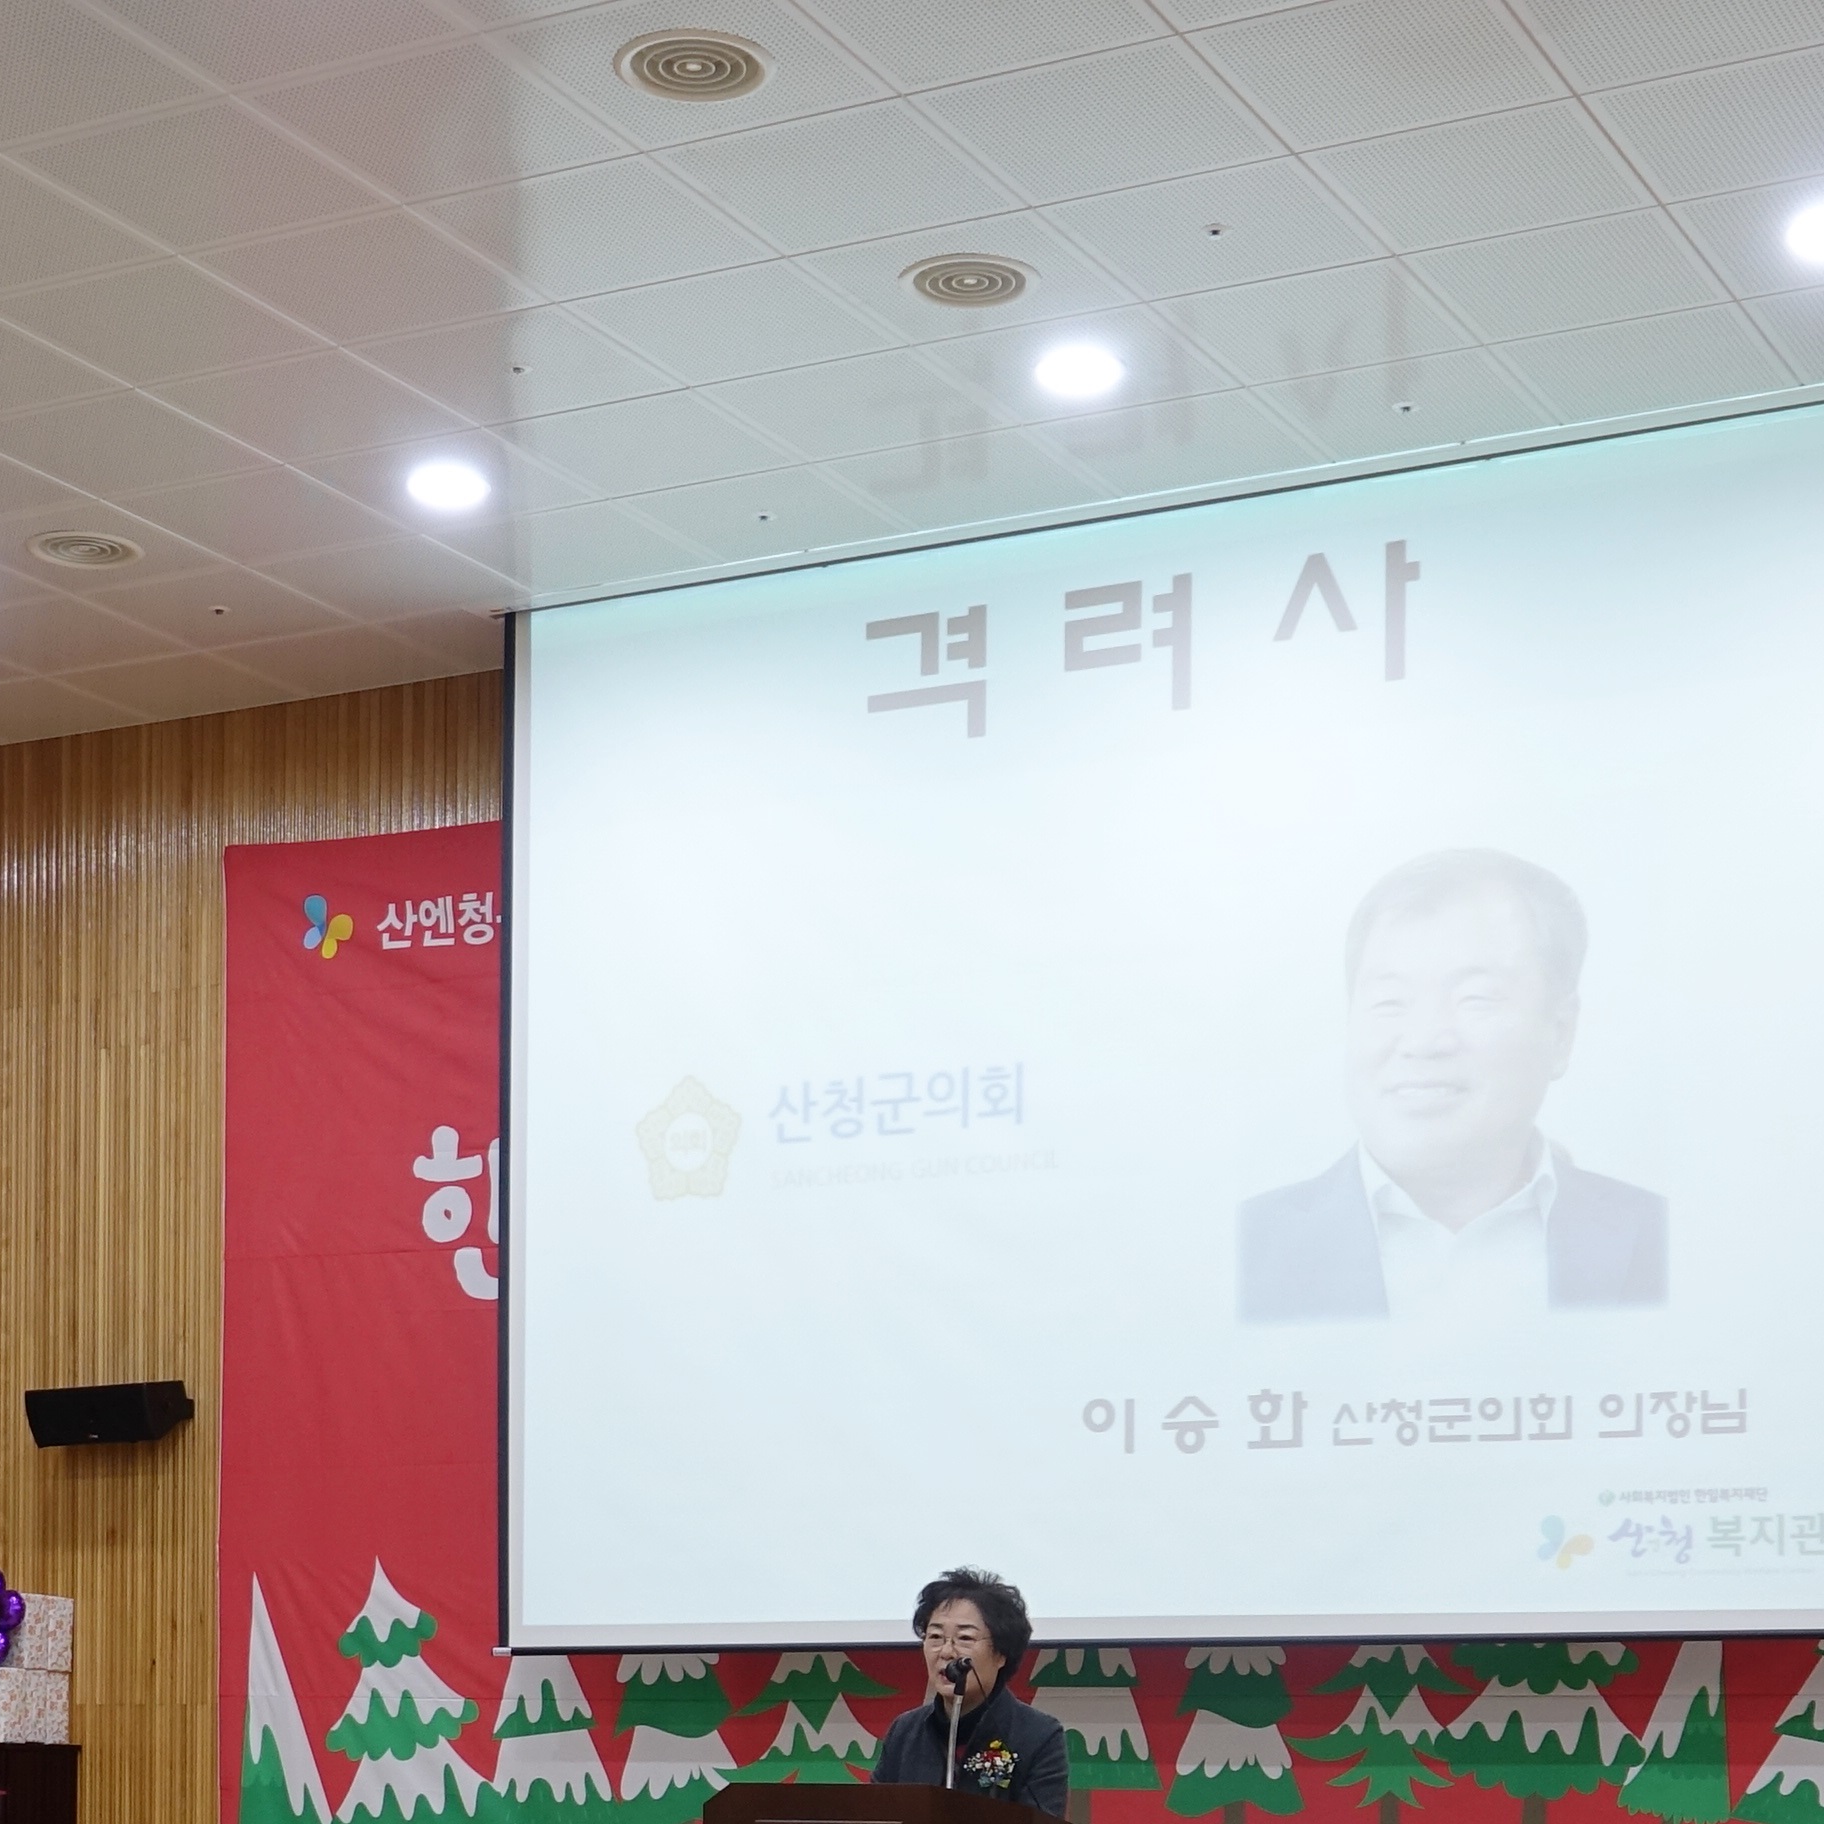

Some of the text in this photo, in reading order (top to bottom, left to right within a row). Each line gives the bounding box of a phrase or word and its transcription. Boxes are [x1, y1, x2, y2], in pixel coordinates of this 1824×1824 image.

[377, 891, 501, 950] 산엔청
[769, 1062, 1024, 1144] 산청군의회
[1331, 1394, 1575, 1449] 산청군의회
[1599, 1386, 1750, 1439] 의장님
